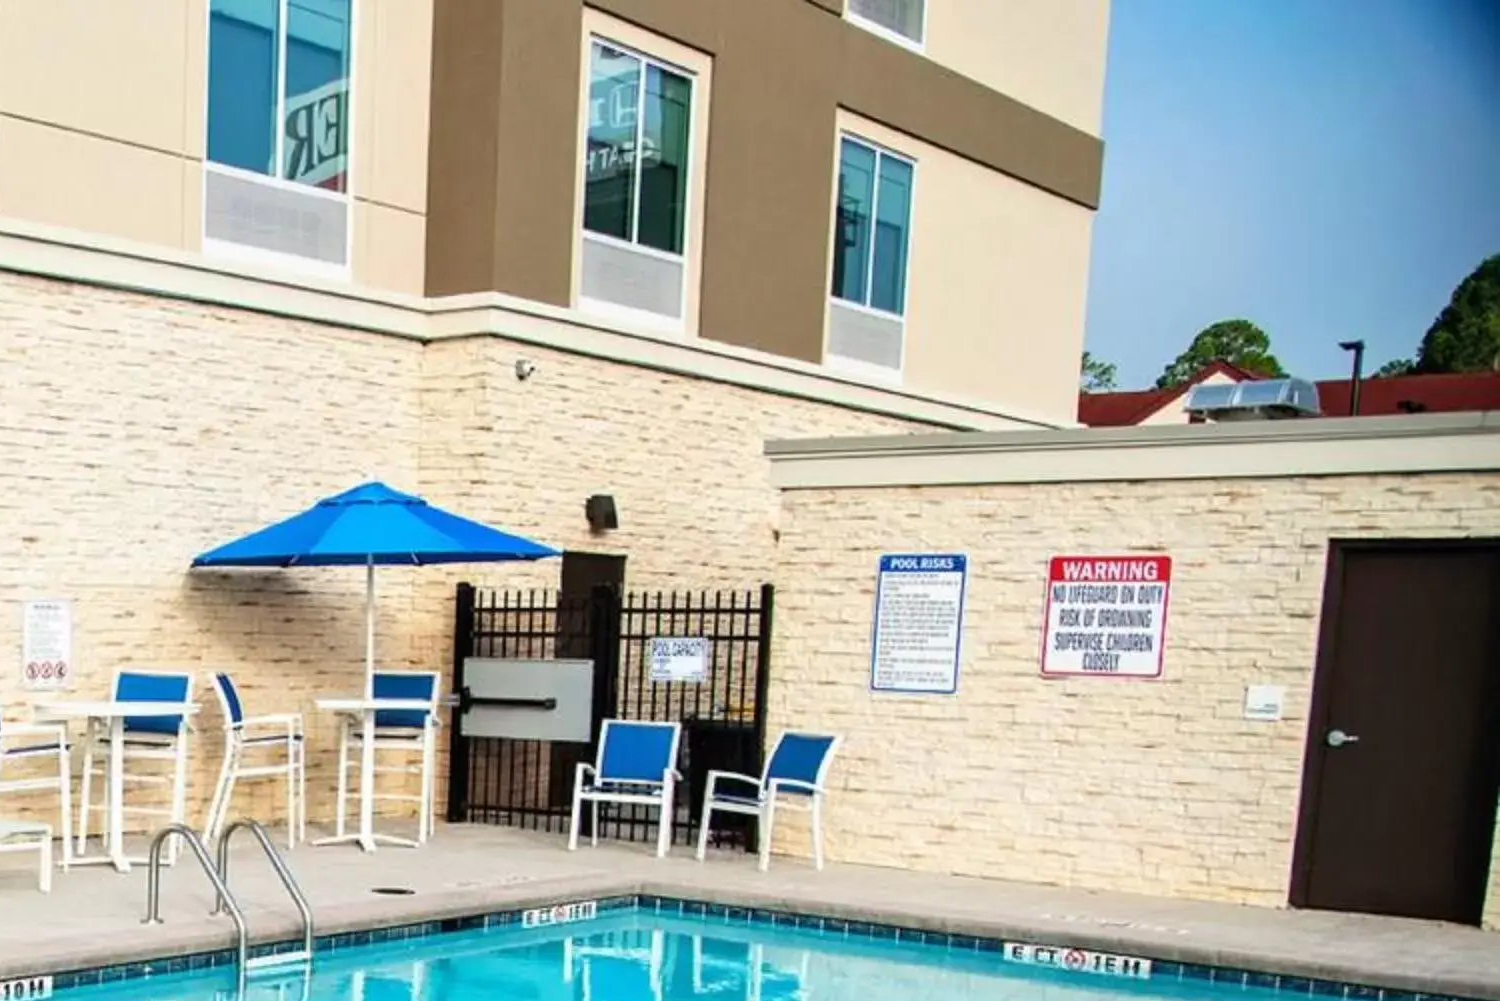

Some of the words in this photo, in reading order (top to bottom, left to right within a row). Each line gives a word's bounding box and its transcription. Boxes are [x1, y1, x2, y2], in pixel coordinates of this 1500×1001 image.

[890, 557, 918, 570] POOL
[920, 557, 954, 570] RISKS
[1062, 561, 1159, 581] WARNING
[1053, 584, 1067, 603] NO
[1068, 584, 1119, 604] LIFEGUARD
[1121, 584, 1135, 604] ON
[1138, 585, 1163, 605] DUTY
[1059, 608, 1080, 627] RISK
[1083, 608, 1096, 628] OF
[1098, 608, 1153, 629] DROWNING
[1054, 631, 1105, 651] SUPERVISE
[1106, 632, 1154, 652] CHILDREN
[1082, 652, 1122, 671] CLOSELY
